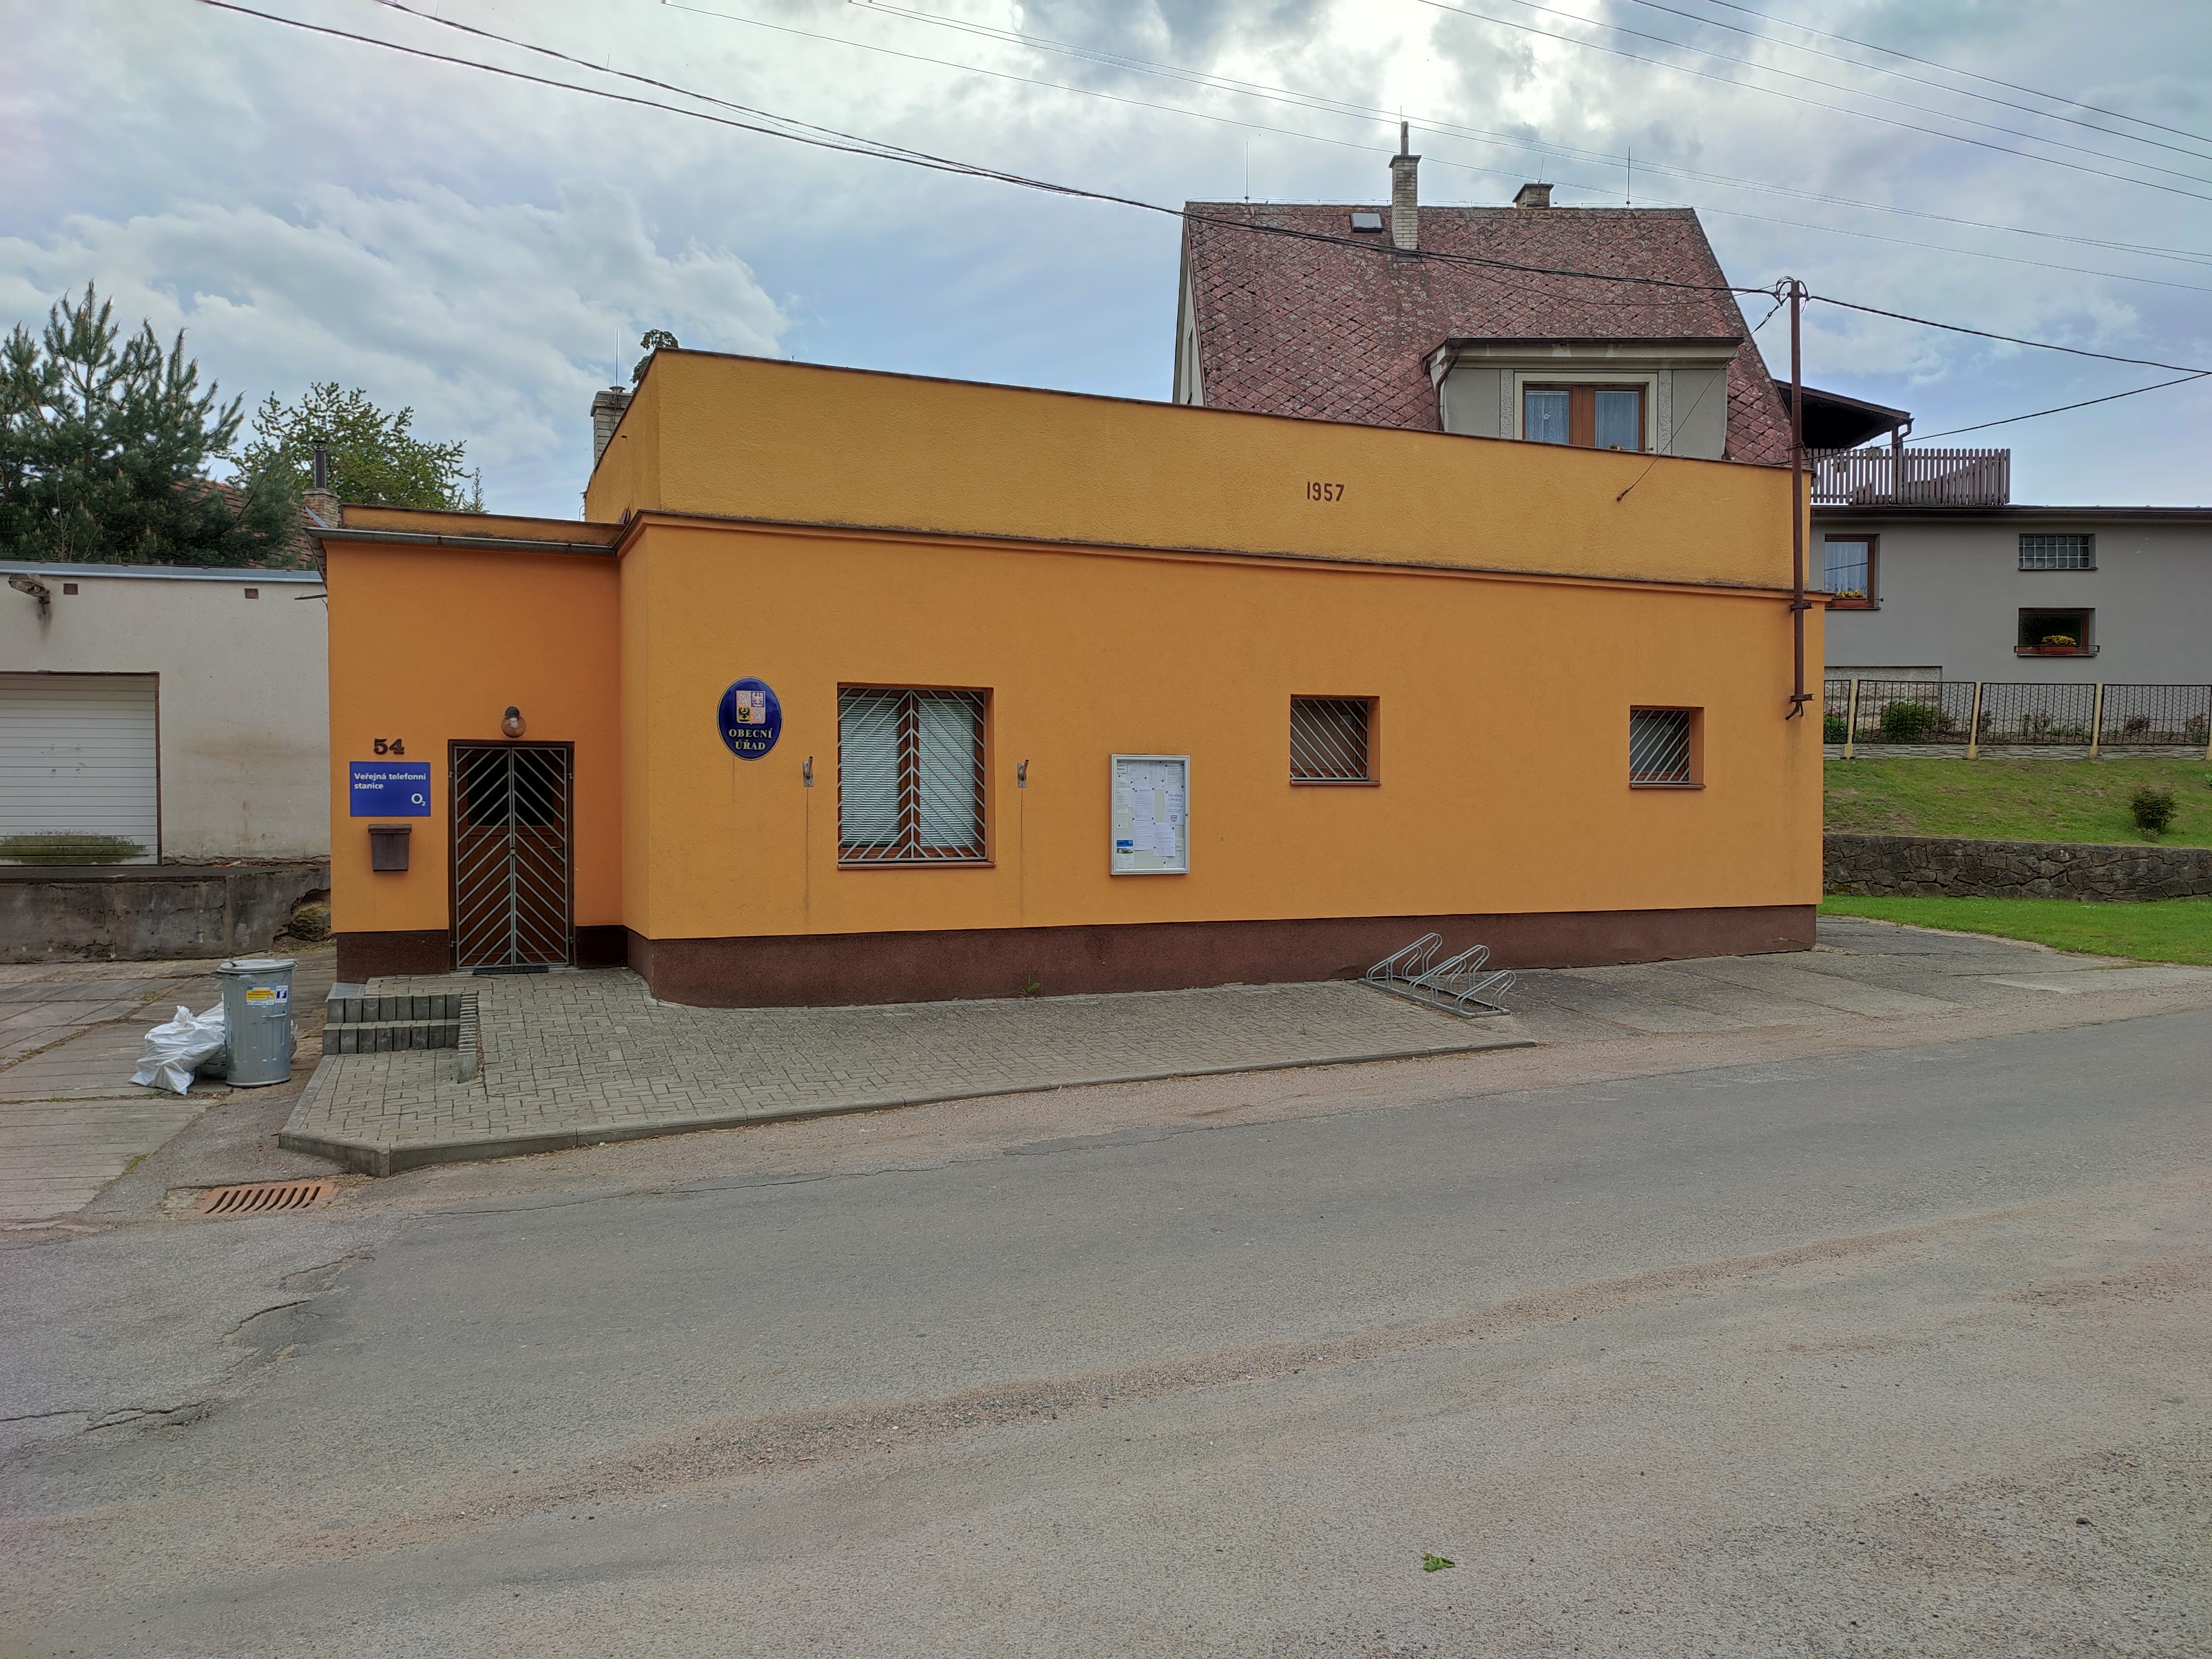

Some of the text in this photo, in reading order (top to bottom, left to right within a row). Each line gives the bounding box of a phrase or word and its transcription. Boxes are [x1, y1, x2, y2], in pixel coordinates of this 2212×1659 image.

[1307, 481, 1344, 502] 1957
[729, 727, 773, 739] OBECNÍ
[374, 738, 405, 755] 54
[735, 739, 766, 750] ÚŘAD
[354, 773, 387, 782] Veřejná
